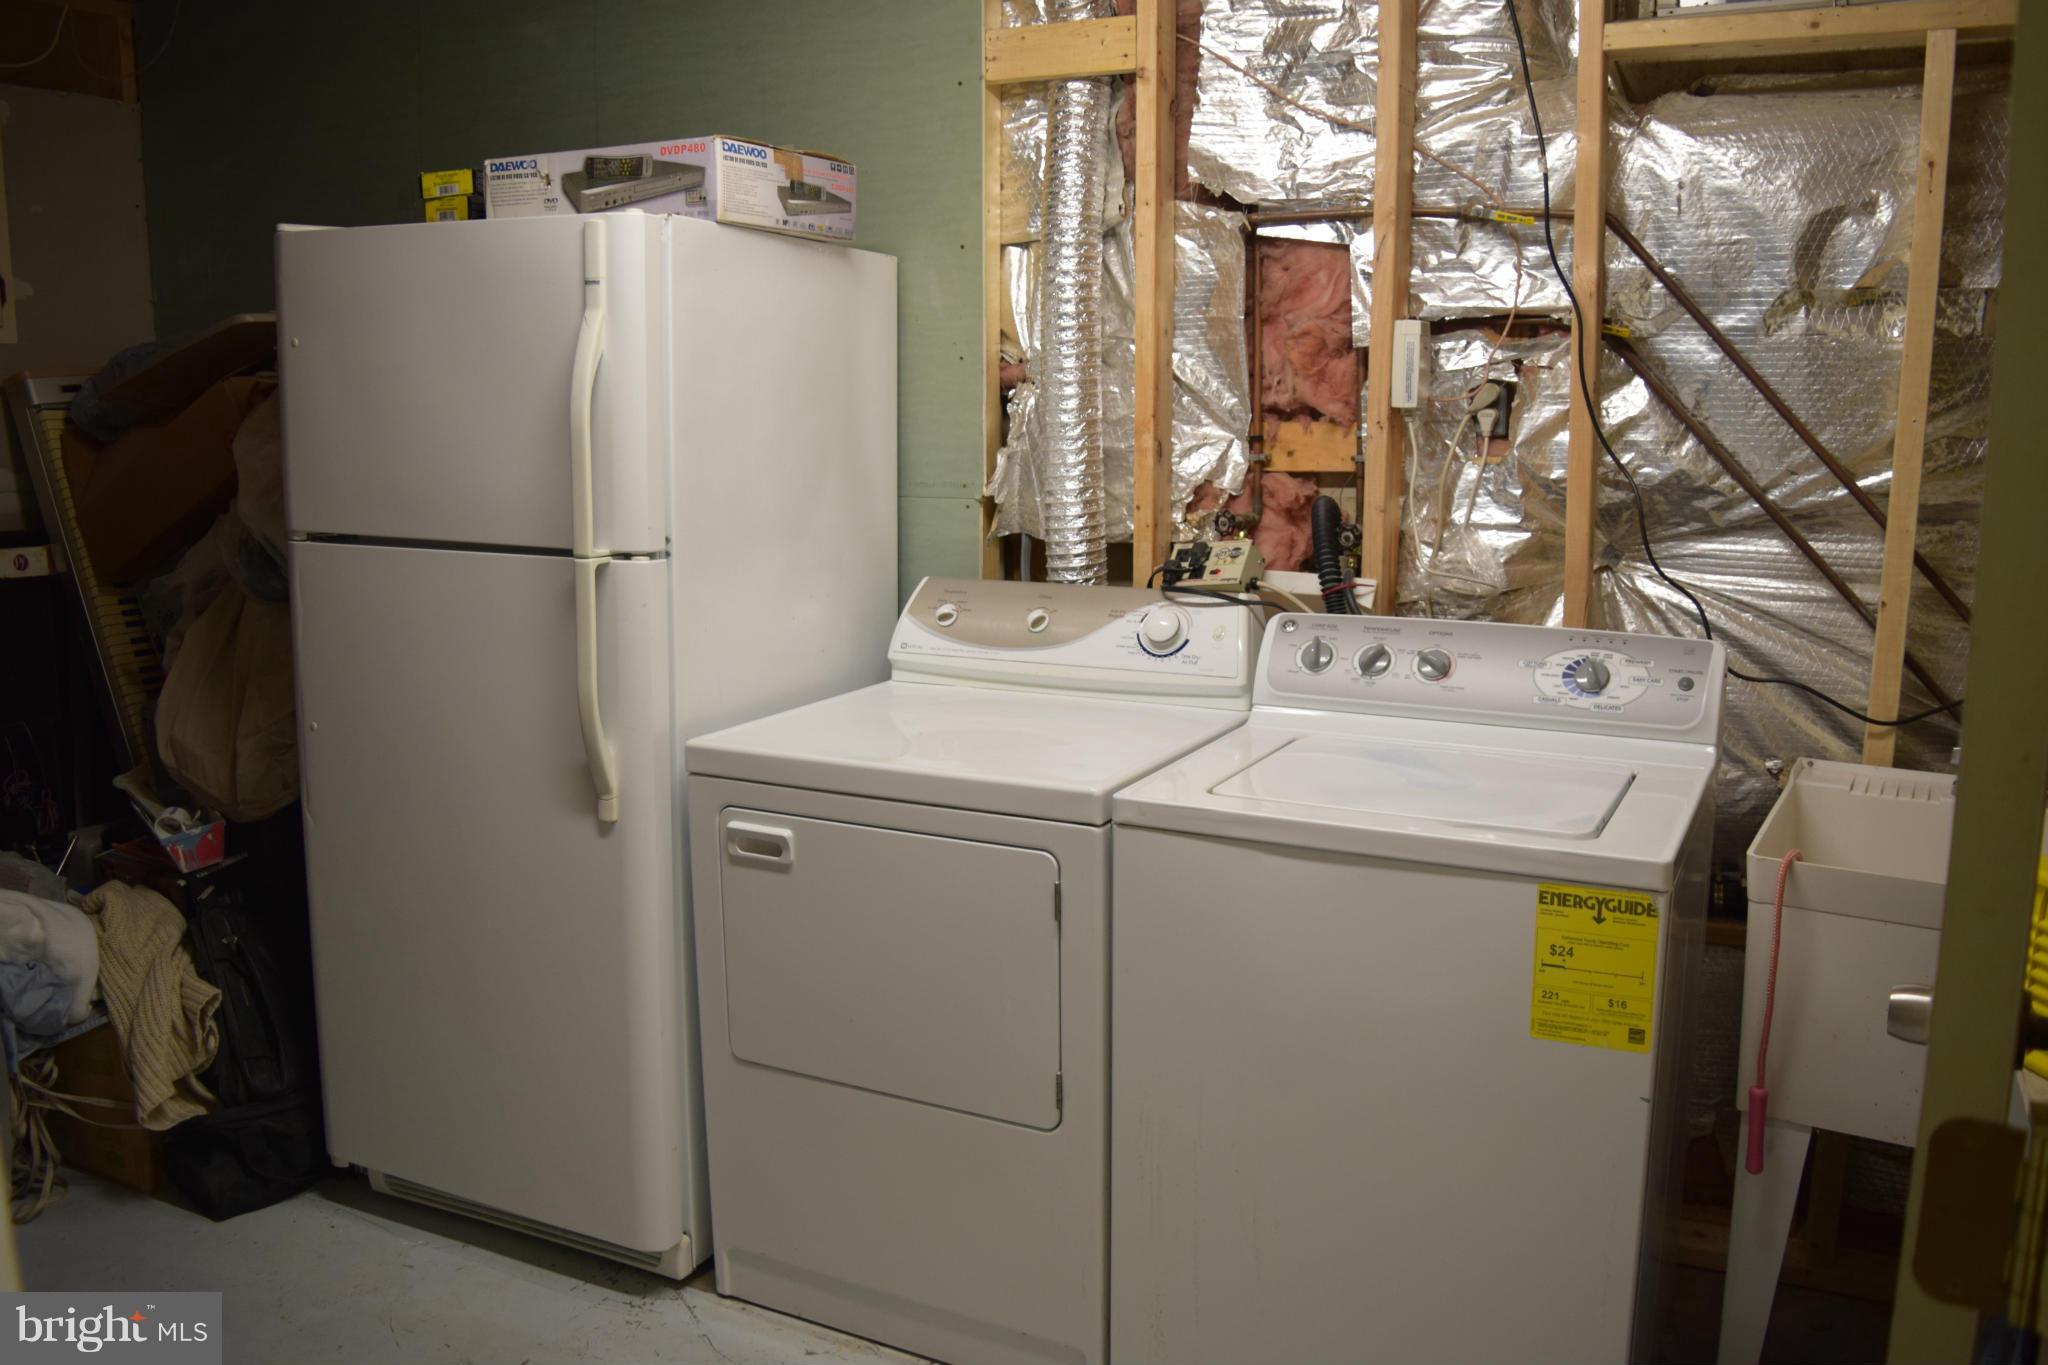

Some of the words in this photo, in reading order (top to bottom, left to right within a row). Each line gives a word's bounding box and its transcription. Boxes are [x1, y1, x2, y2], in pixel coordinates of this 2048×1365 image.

[660, 142, 706, 156] DVDP480
[722, 141, 767, 159] DAEWOO
[490, 160, 537, 173] DAEWOO
[1593, 703, 1622, 711] DELICATES
[1549, 943, 1575, 958] $24
[1541, 990, 1559, 1001] 221
[1607, 998, 1628, 1010] $16
